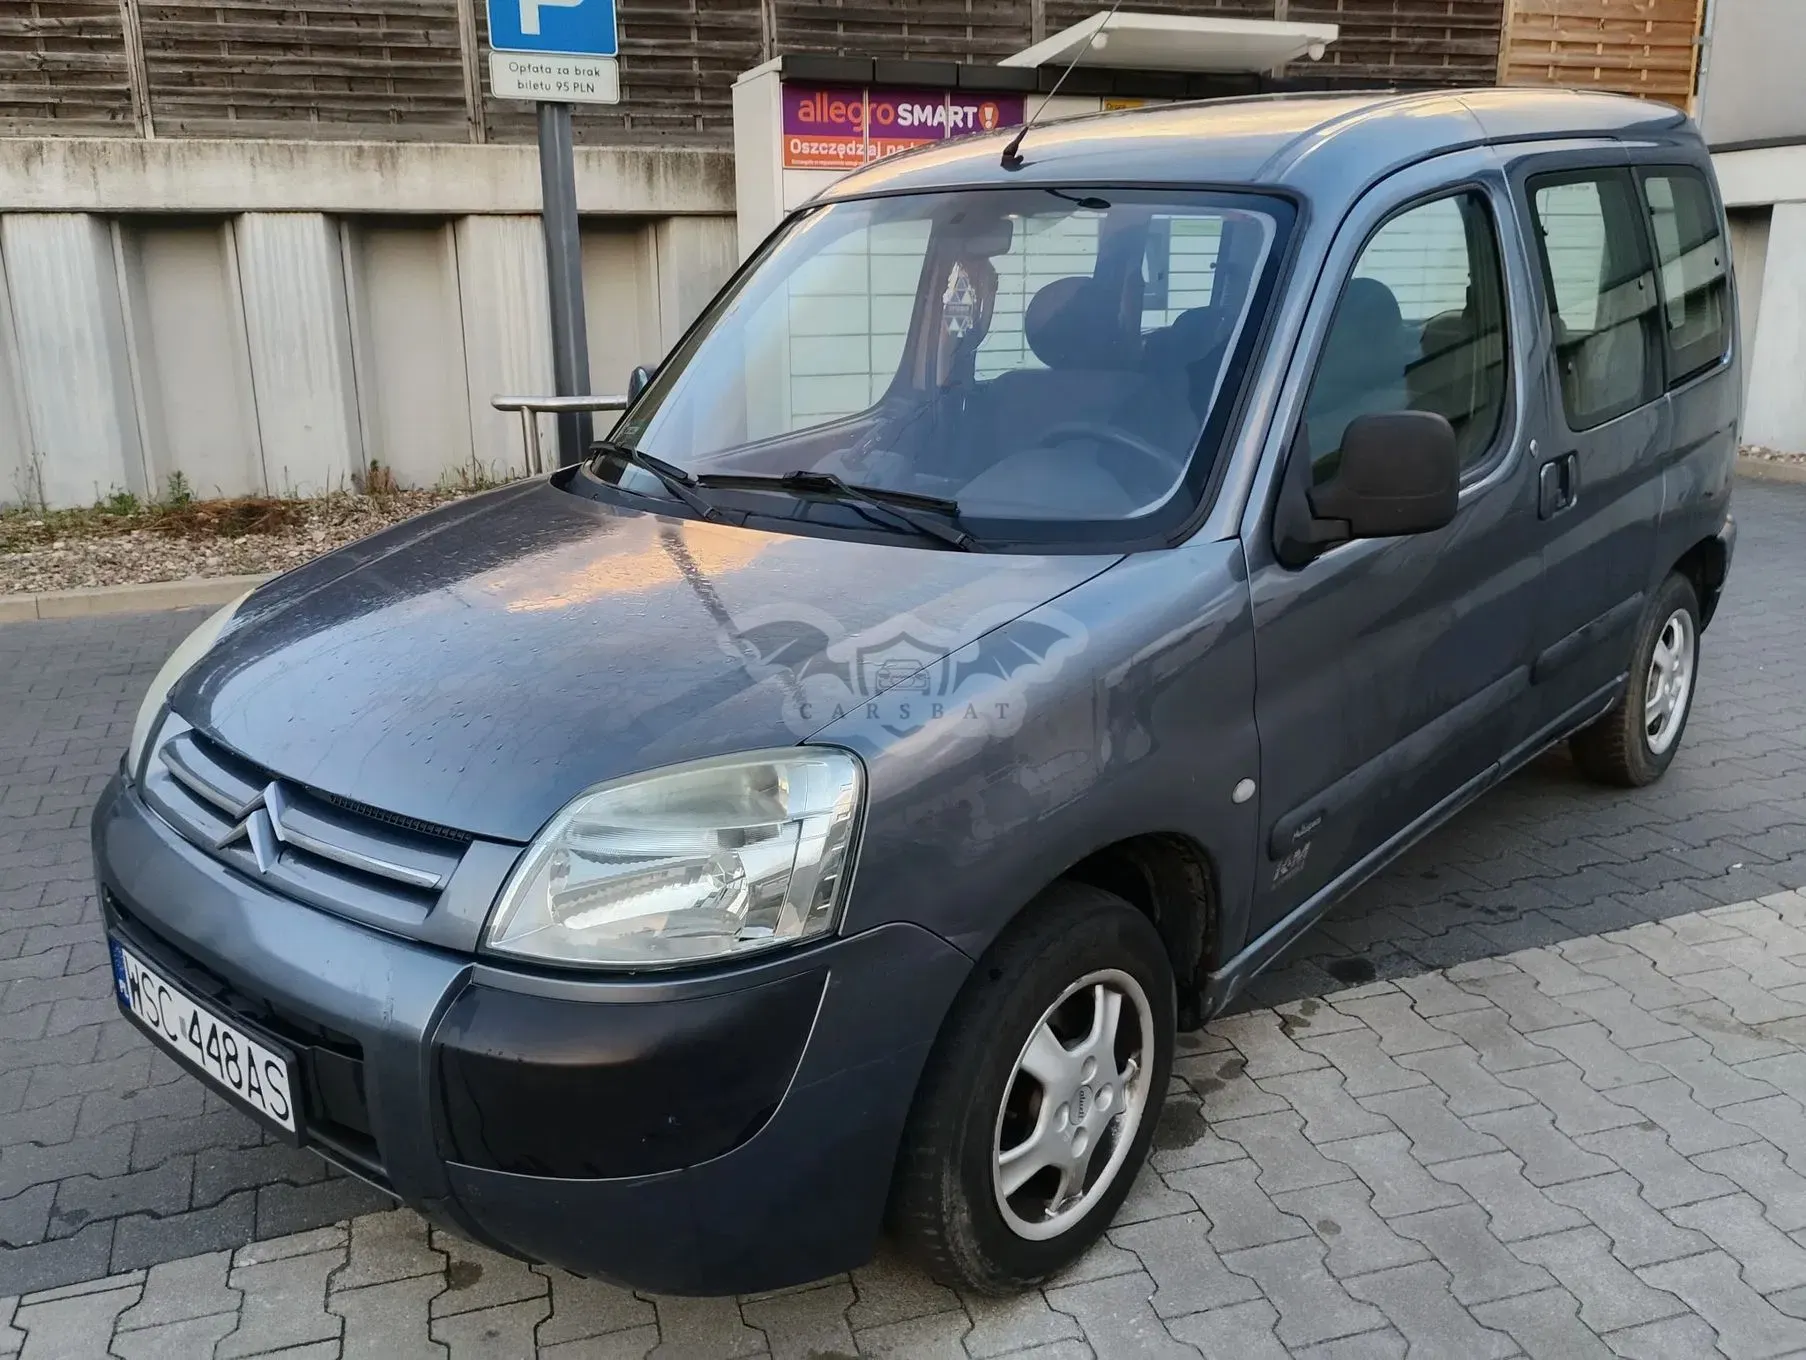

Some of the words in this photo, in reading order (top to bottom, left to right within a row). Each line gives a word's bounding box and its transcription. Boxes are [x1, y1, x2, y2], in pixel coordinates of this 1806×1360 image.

[509, 61, 552, 75] Opłata
[558, 67, 570, 75] za
[575, 65, 601, 77] brak
[517, 80, 551, 91] biletu
[556, 81, 570, 92] 95
[573, 82, 595, 93] PLN
[798, 92, 895, 132] allegro
[790, 138, 881, 159] Oszczędzaj
[125, 955, 179, 1042] WSC
